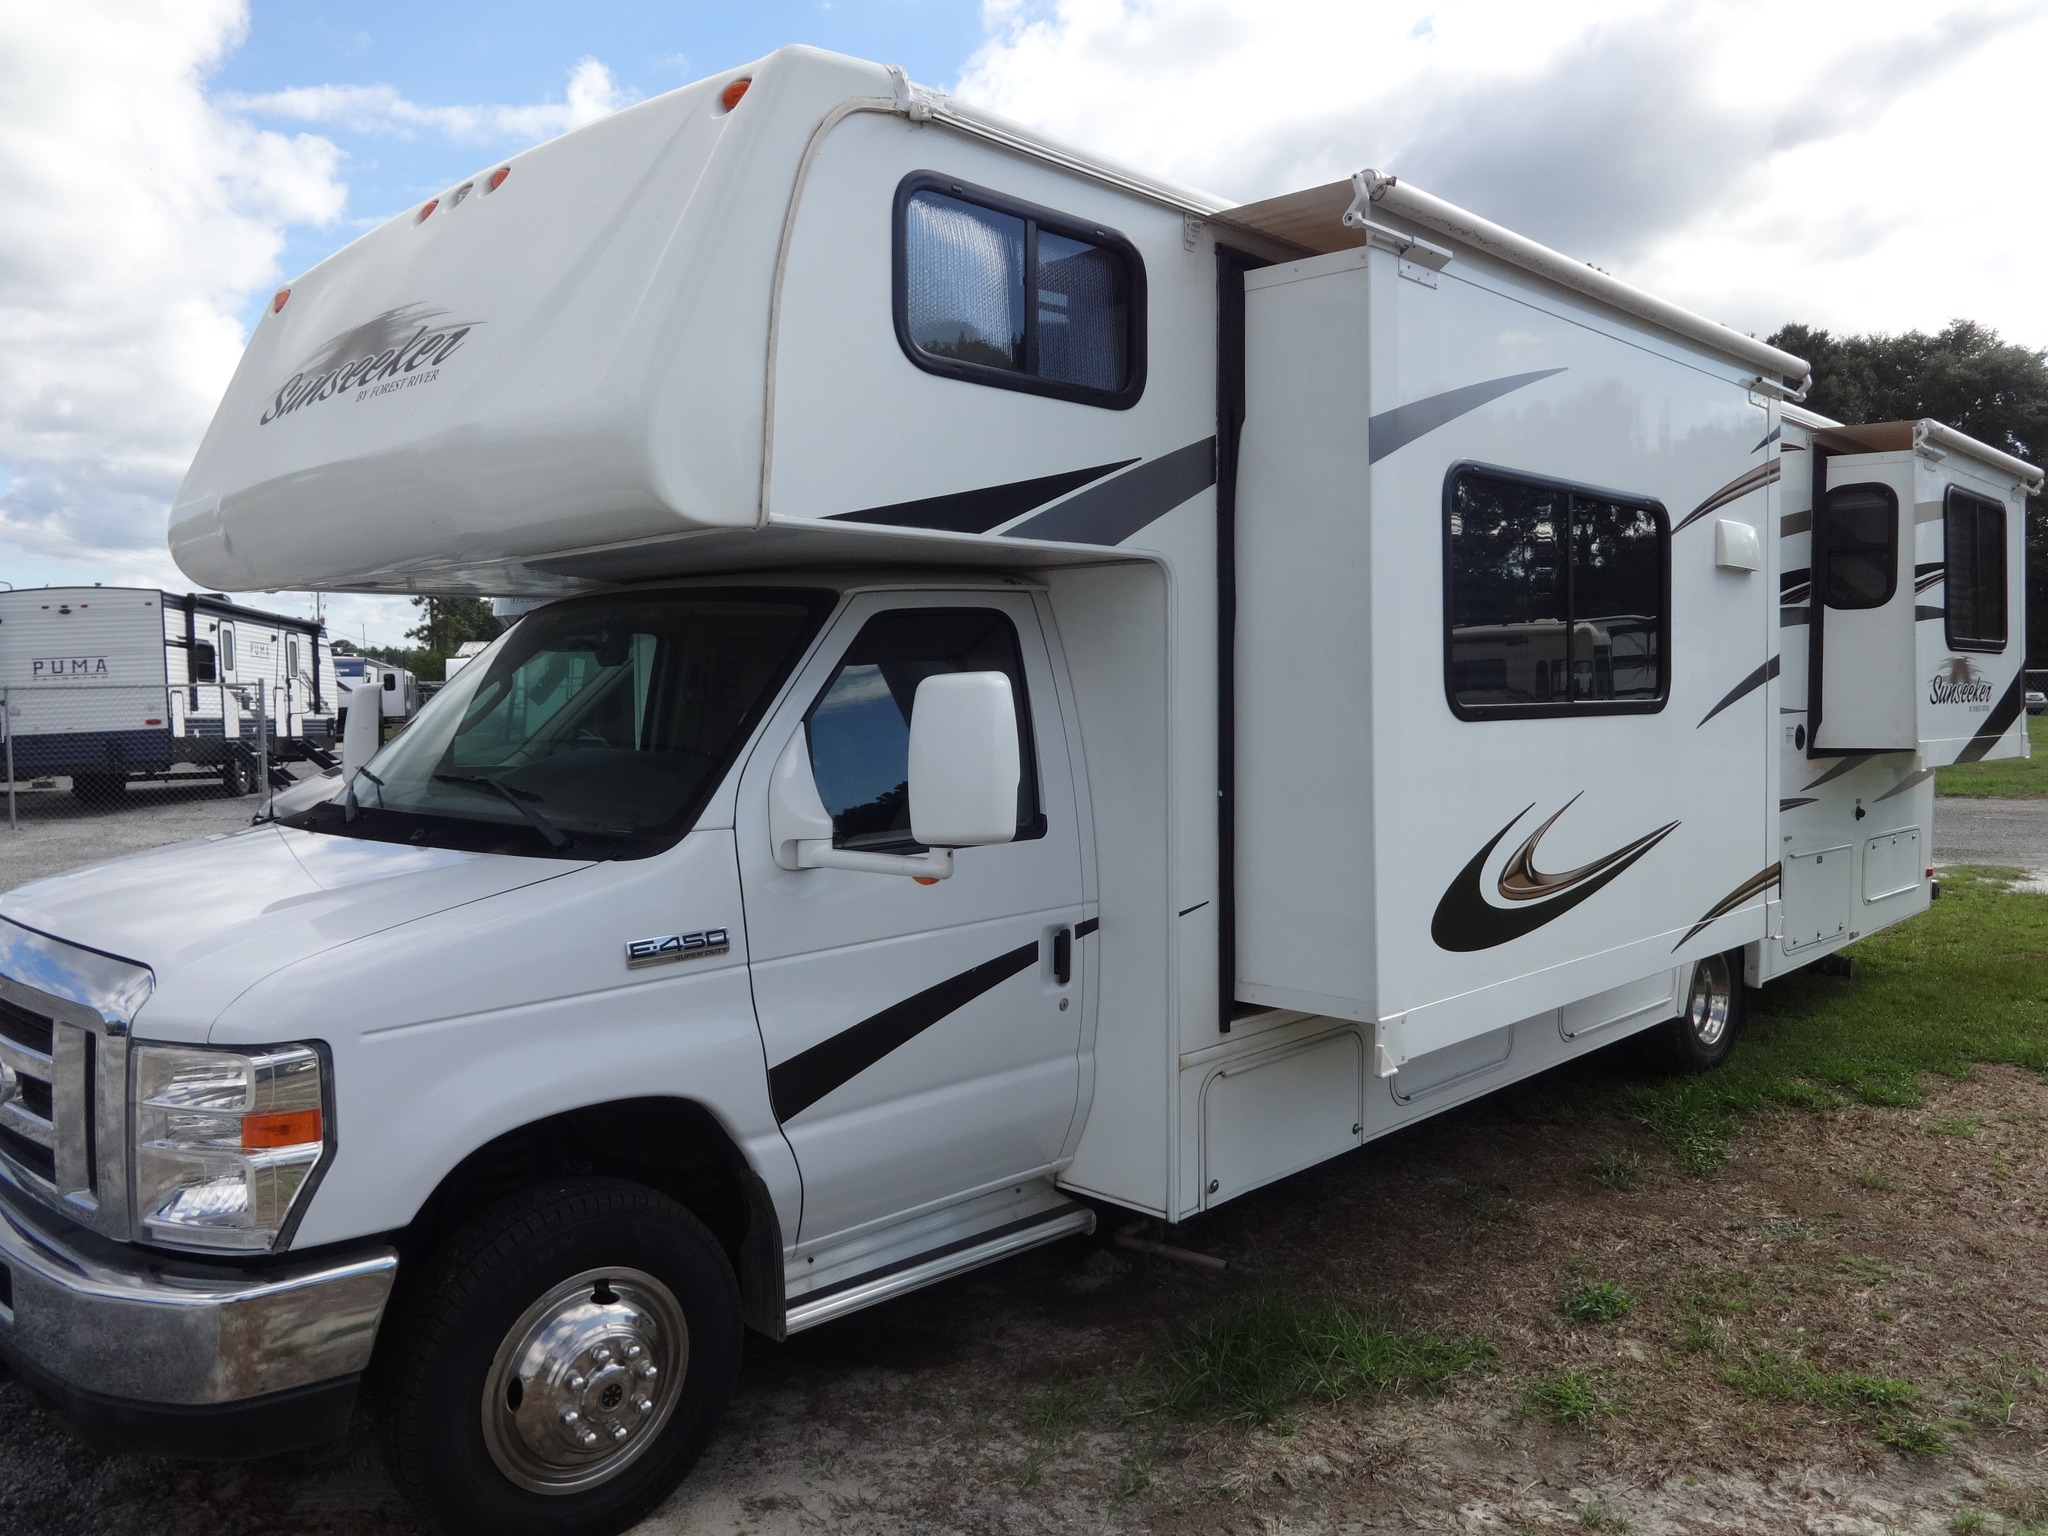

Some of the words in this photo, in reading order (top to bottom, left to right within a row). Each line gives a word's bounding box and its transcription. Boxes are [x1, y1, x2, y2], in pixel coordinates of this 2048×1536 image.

[260, 326, 471, 426] Sunseeker
[356, 389, 370, 402] BY
[370, 378, 408, 398] FOREST
[407, 369, 440, 387] RIVER
[33, 659, 107, 675] PUMA
[1930, 675, 1992, 705] Sunseeker
[674, 952, 703, 961] SUPER
[704, 947, 728, 957] DUTY
